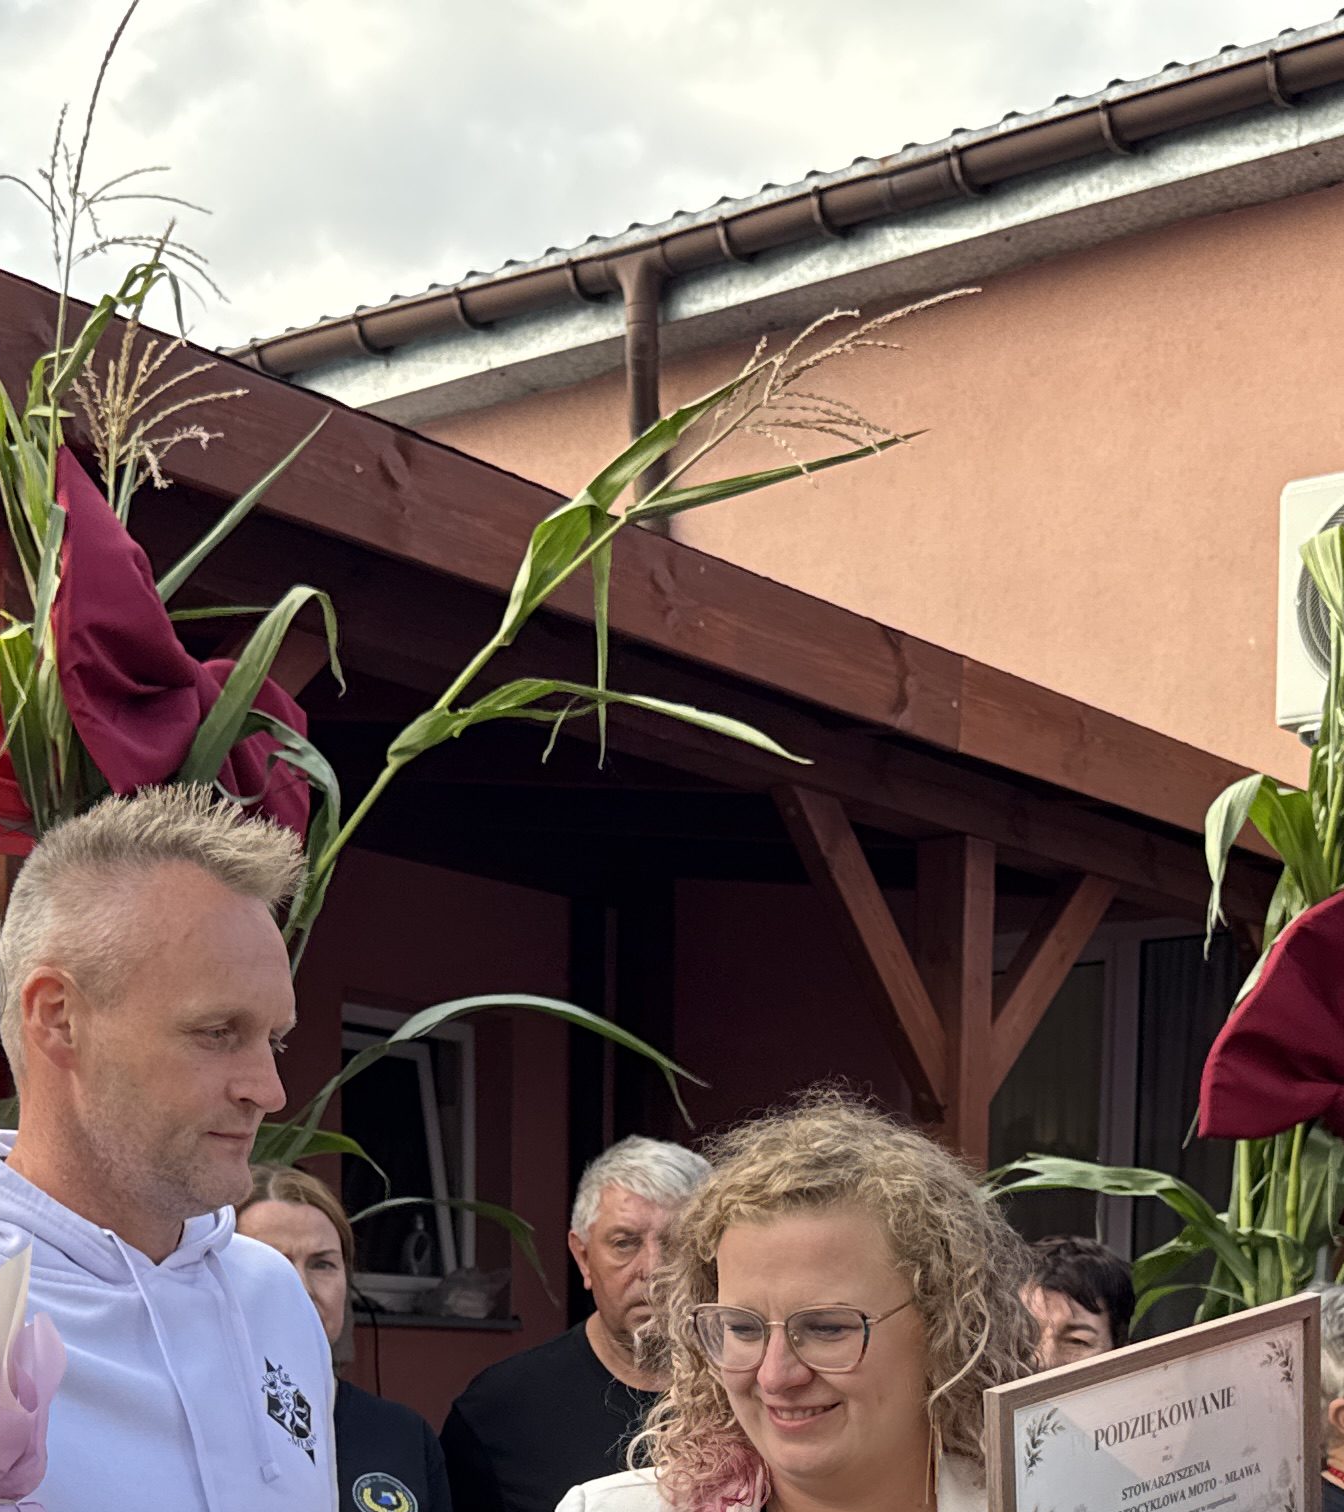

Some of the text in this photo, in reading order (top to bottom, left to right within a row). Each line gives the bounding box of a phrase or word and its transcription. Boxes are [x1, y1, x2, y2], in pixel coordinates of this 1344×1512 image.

[1094, 1386, 1236, 1451] PODZIĘKOWANIE
[1122, 1460, 1211, 1501] STOWARZYSZENIA
[1187, 1478, 1217, 1499] MOTO
